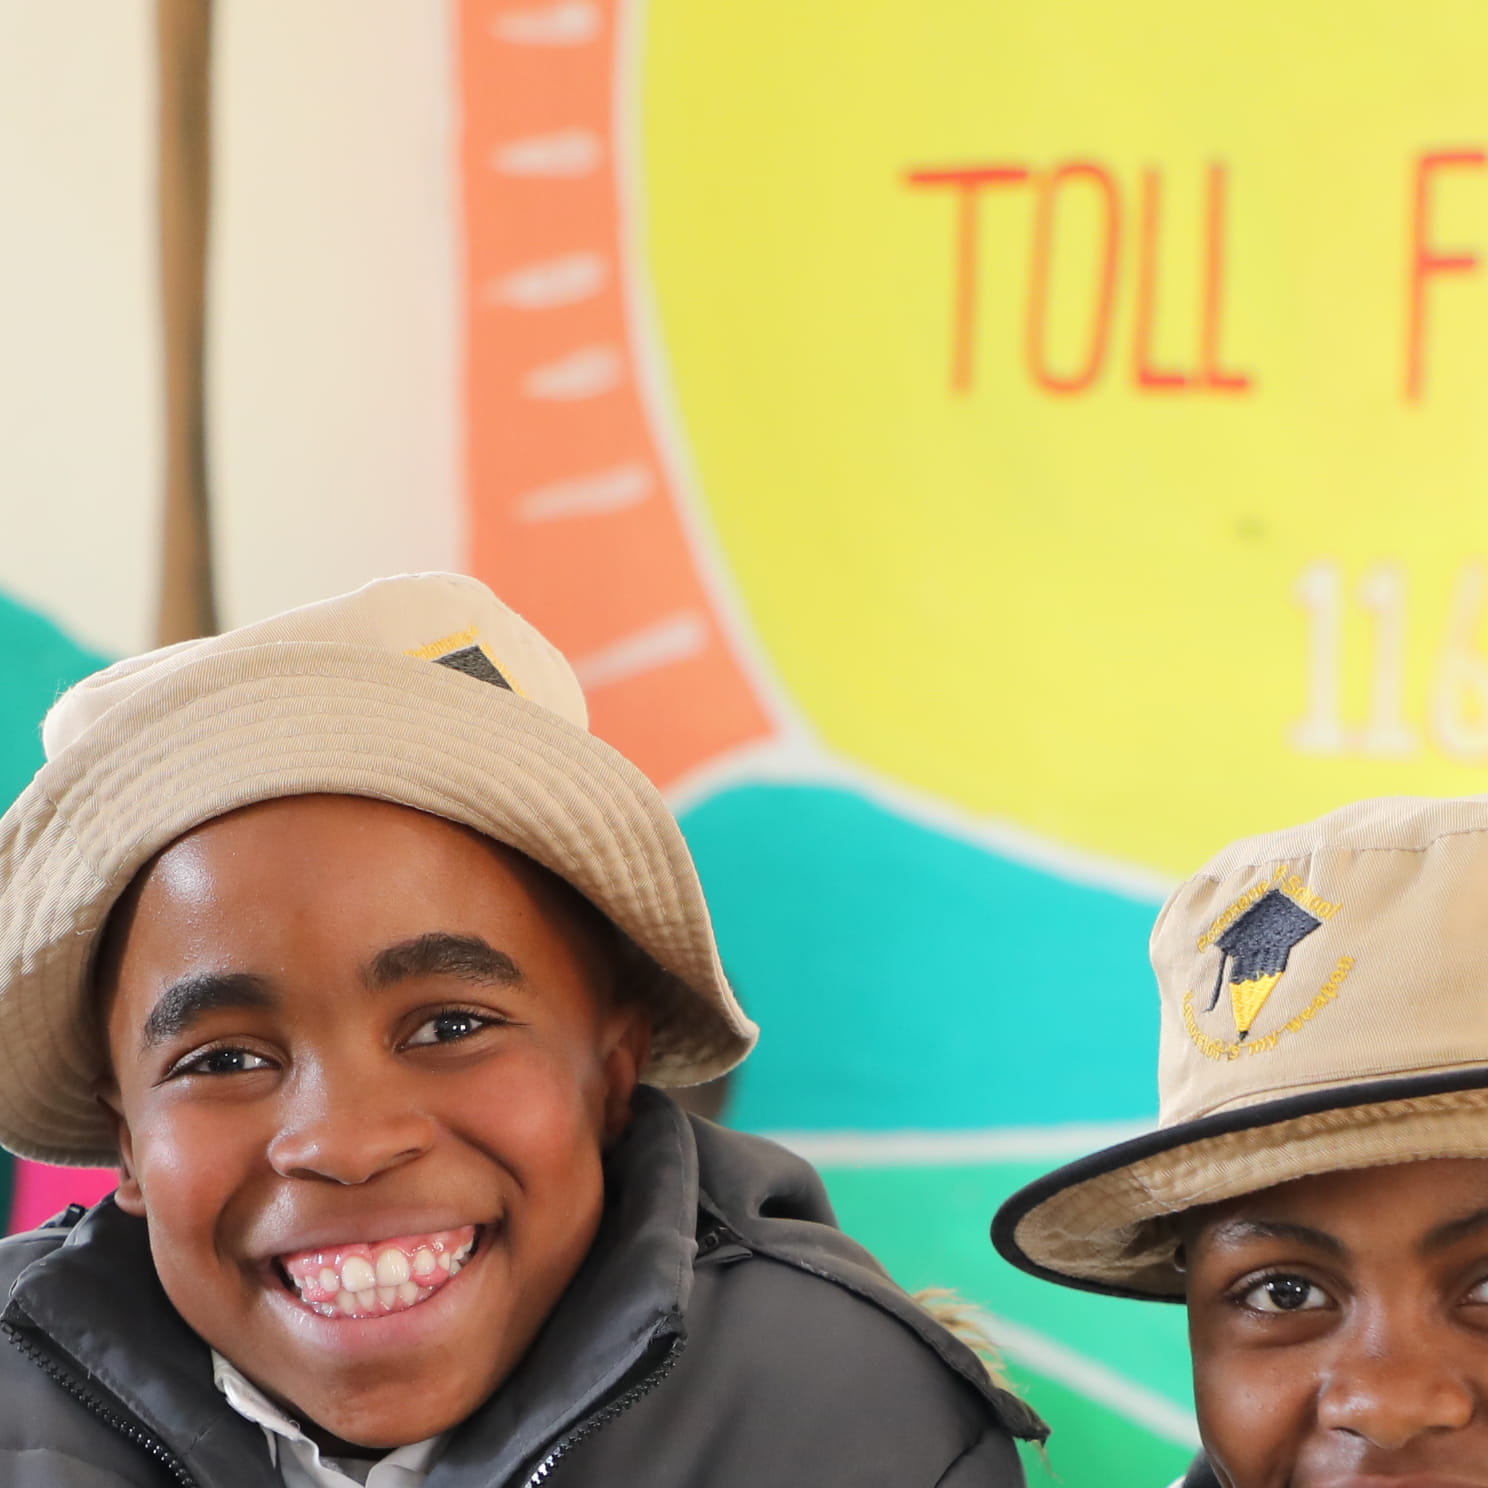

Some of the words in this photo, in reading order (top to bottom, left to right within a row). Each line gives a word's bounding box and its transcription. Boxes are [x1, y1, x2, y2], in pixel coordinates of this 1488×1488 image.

[902, 158, 1255, 396] TOLL
[1281, 874, 1344, 921] School
[1285, 955, 1357, 1034] weapon
